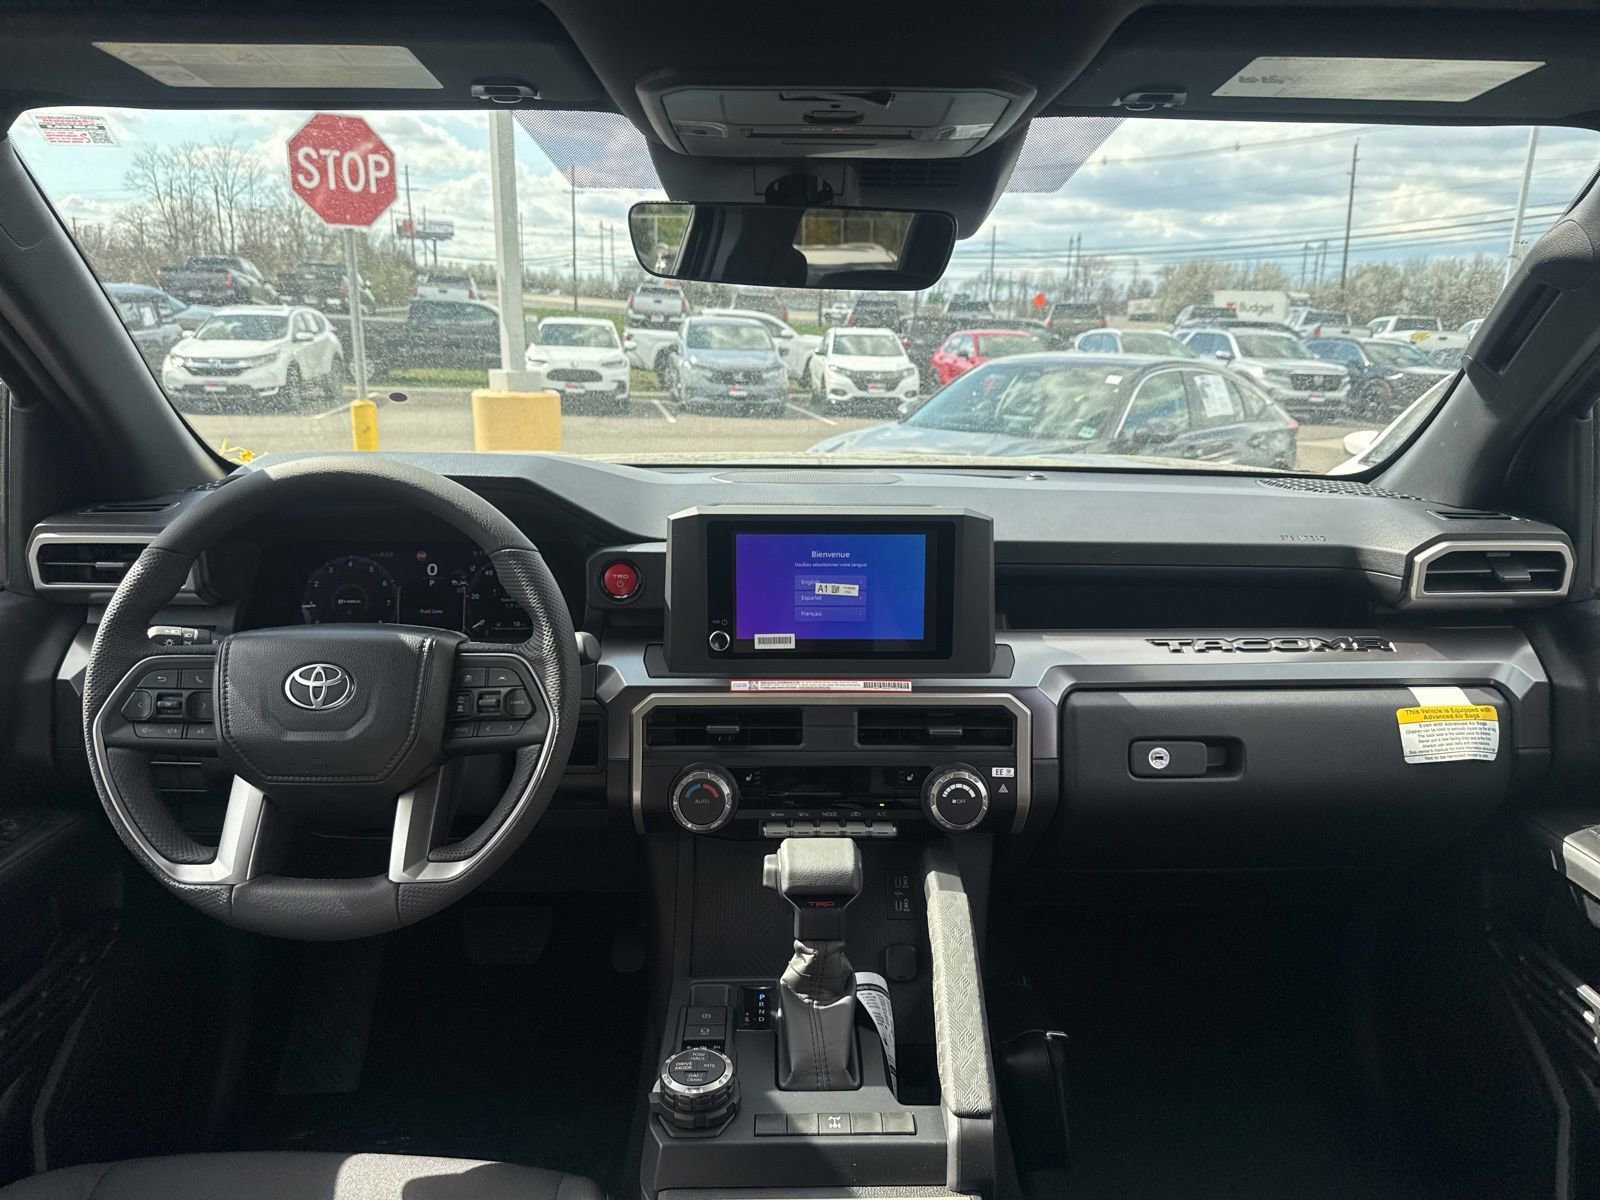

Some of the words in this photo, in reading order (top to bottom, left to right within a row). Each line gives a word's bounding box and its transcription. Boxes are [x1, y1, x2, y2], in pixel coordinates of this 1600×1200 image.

[297, 146, 390, 193] STOP
[1239, 301, 1275, 316] Budget
[811, 550, 851, 559] Bienvenue
[427, 563, 438, 576] 0
[817, 585, 828, 593] A1
[1145, 636, 1398, 654] TACOMA
[1450, 707, 1479, 715] Equipped
[1464, 712, 1480, 720] Bags
